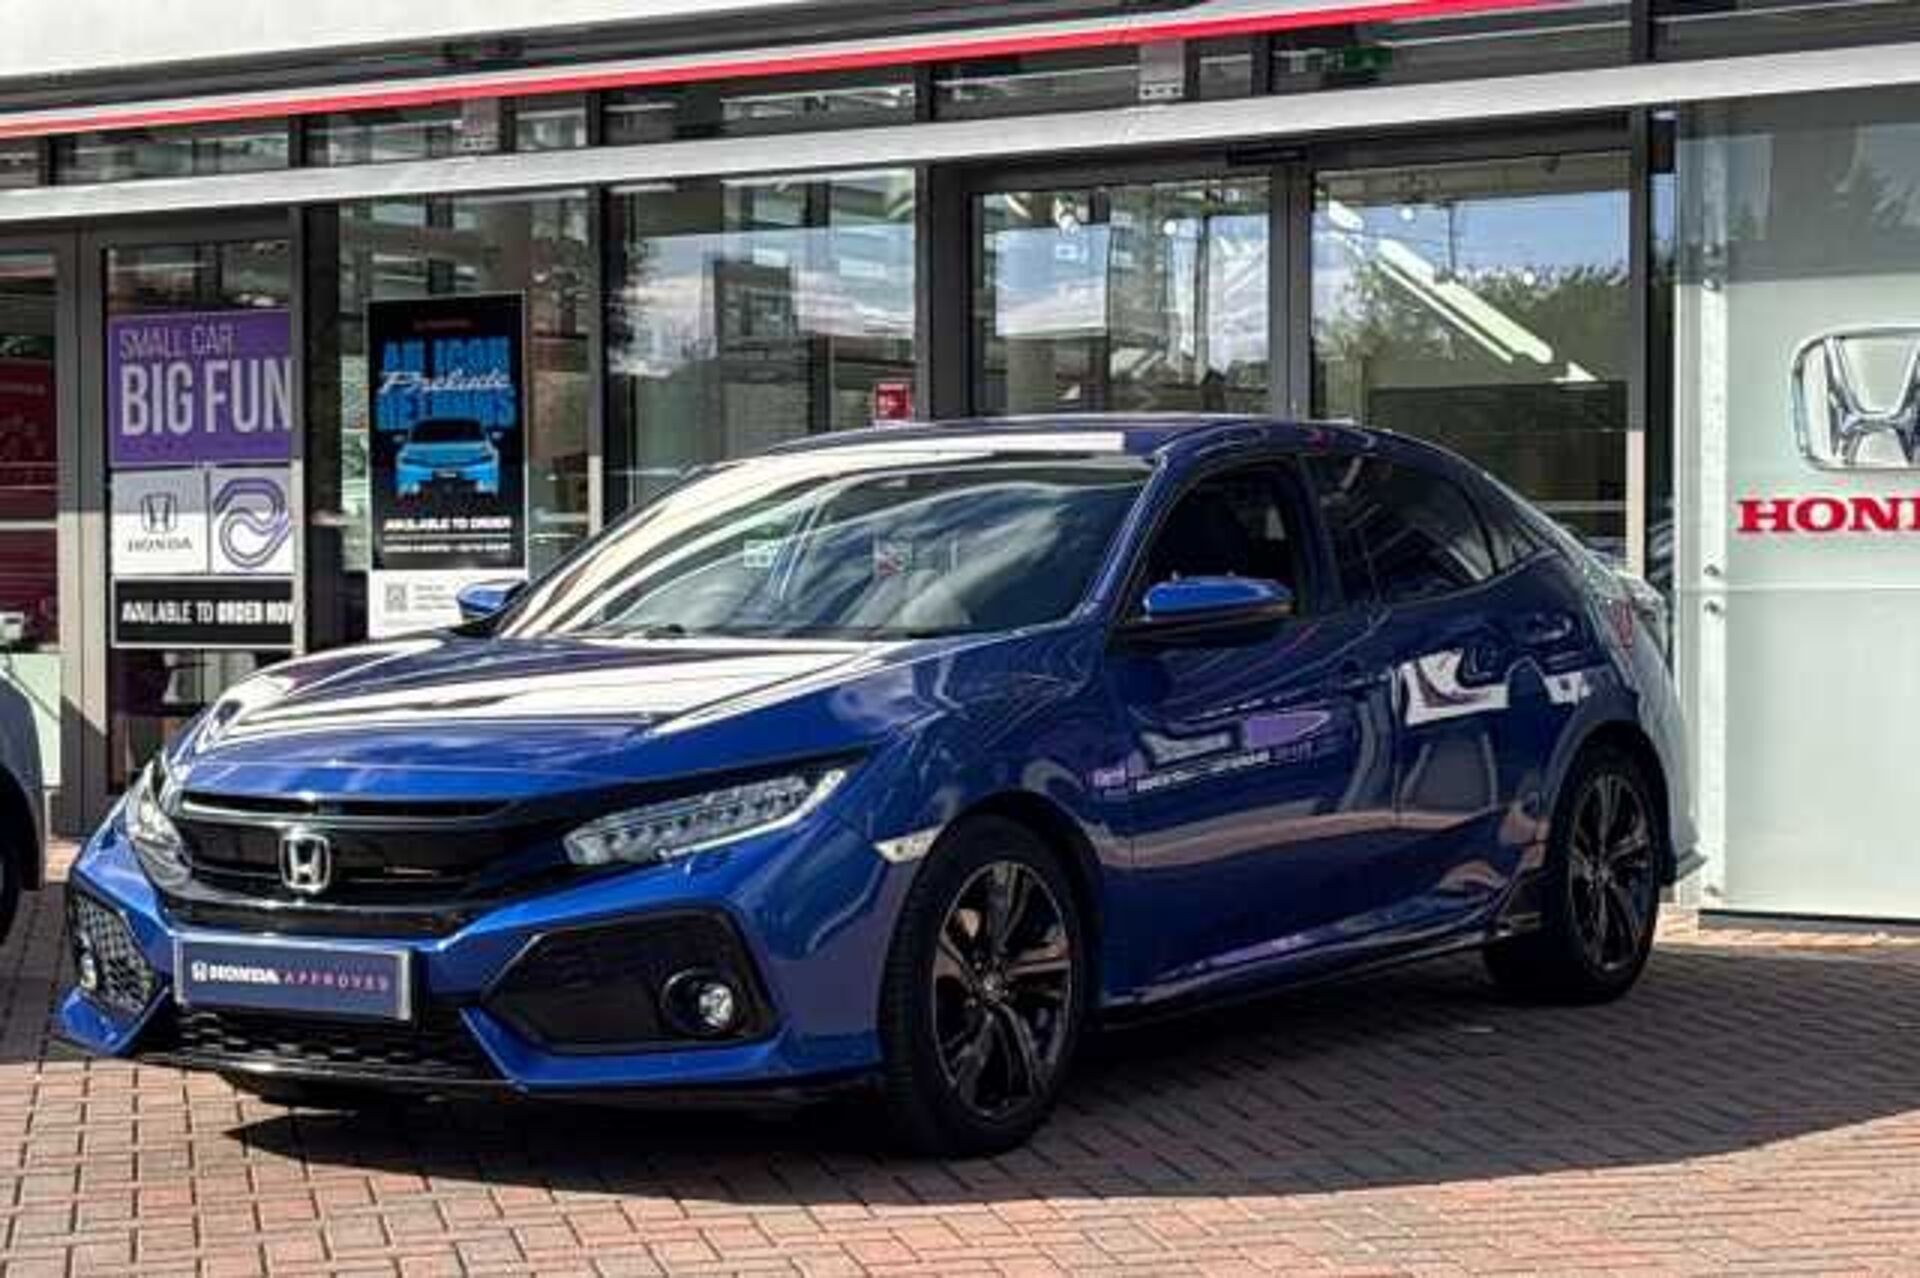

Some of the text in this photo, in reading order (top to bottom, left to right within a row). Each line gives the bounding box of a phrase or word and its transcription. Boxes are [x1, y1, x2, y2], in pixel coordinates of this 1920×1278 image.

[119, 323, 235, 360] SMALL CAR
[121, 357, 294, 436] BIG FUN
[127, 535, 192, 552] HONDA
[121, 602, 193, 625] AVAILABLE
[197, 602, 214, 624] TO
[217, 602, 262, 624] ORDER
[209, 964, 390, 992] HONDA APPROVED
